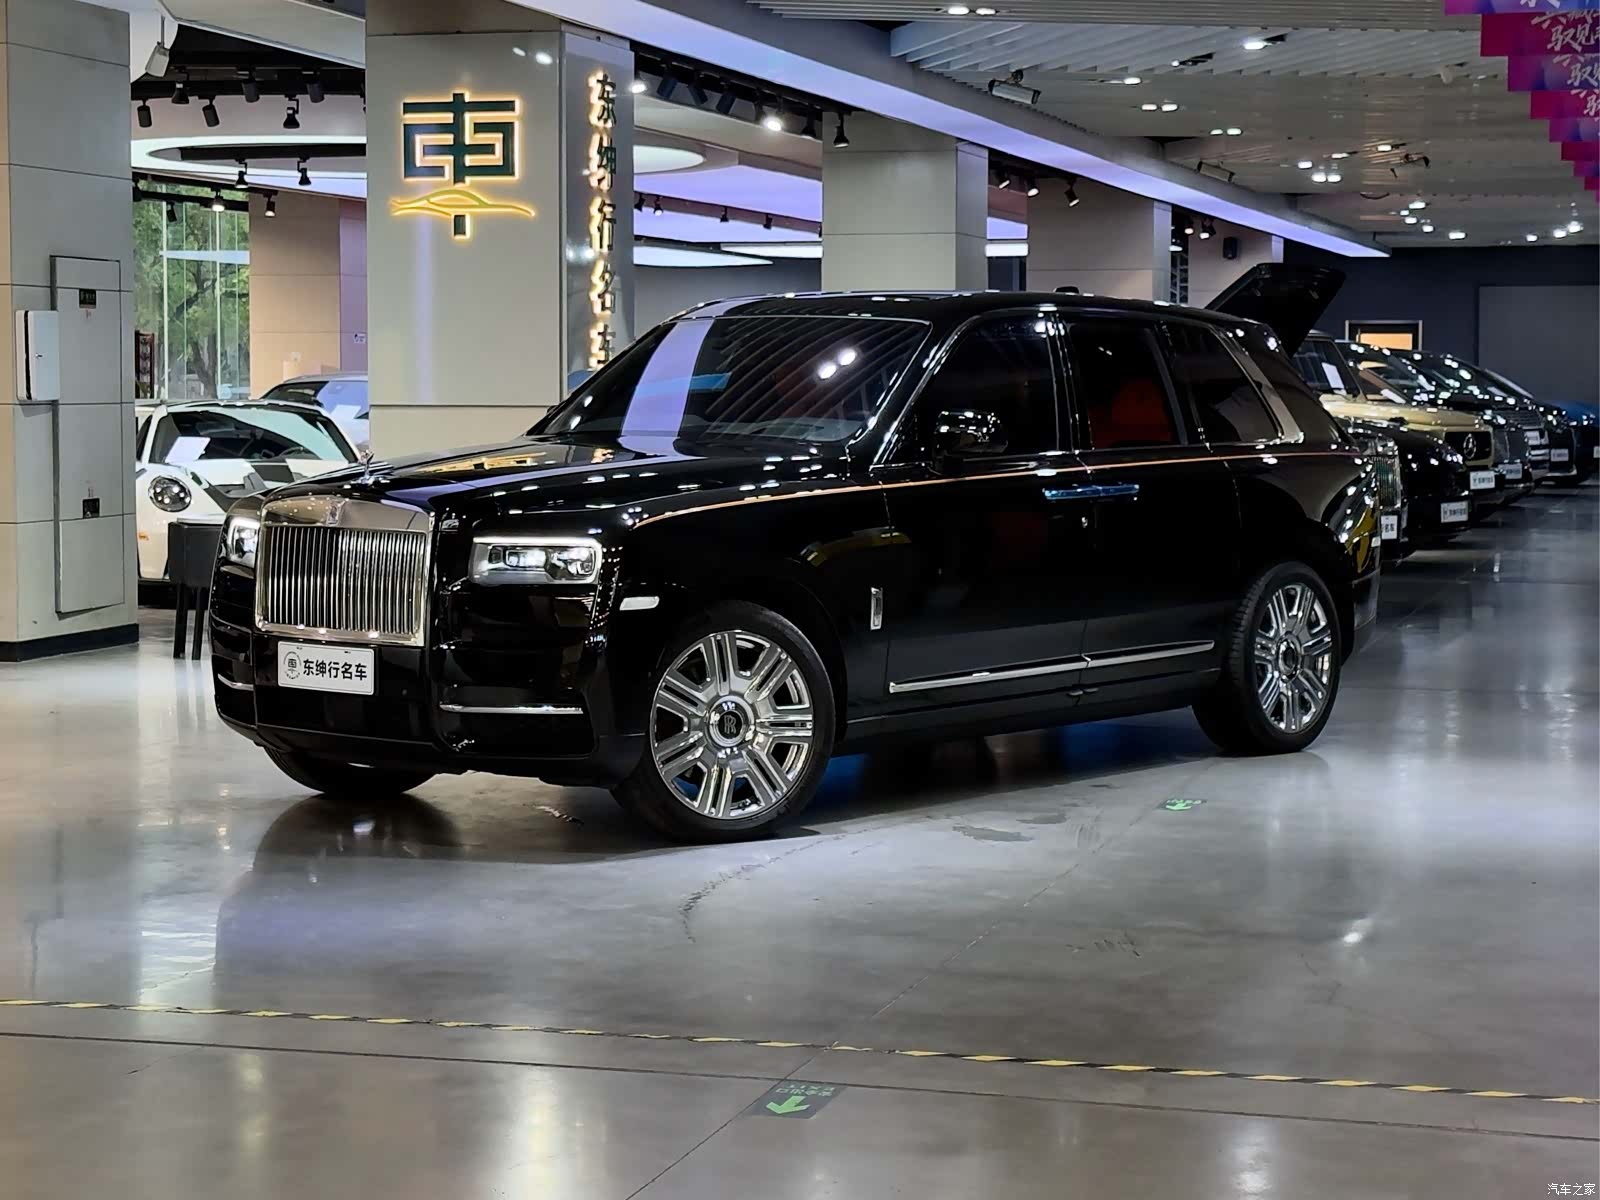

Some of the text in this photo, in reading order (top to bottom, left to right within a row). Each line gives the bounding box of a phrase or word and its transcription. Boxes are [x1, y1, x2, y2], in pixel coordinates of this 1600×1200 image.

[303, 658, 367, 681] 东绅行名车
